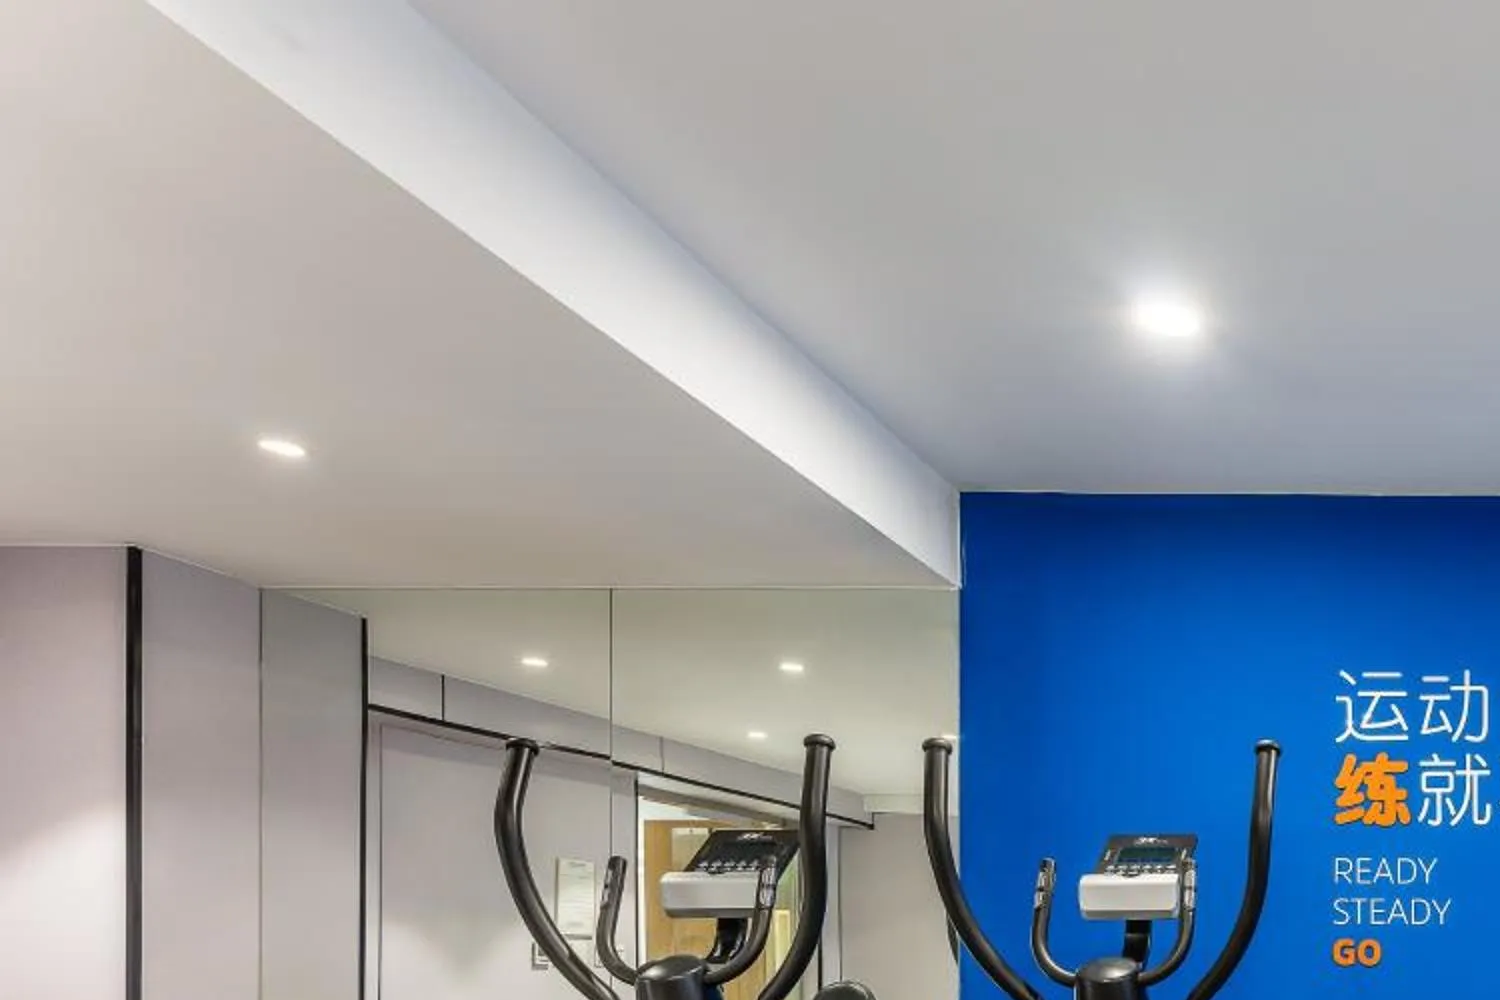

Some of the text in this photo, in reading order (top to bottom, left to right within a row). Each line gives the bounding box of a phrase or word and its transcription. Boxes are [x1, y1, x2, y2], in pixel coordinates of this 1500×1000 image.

[1334, 668, 1490, 743] 运动
[1334, 857, 1438, 885] READY
[1332, 898, 1452, 926] STEADY
[1332, 938, 1382, 968] GO
